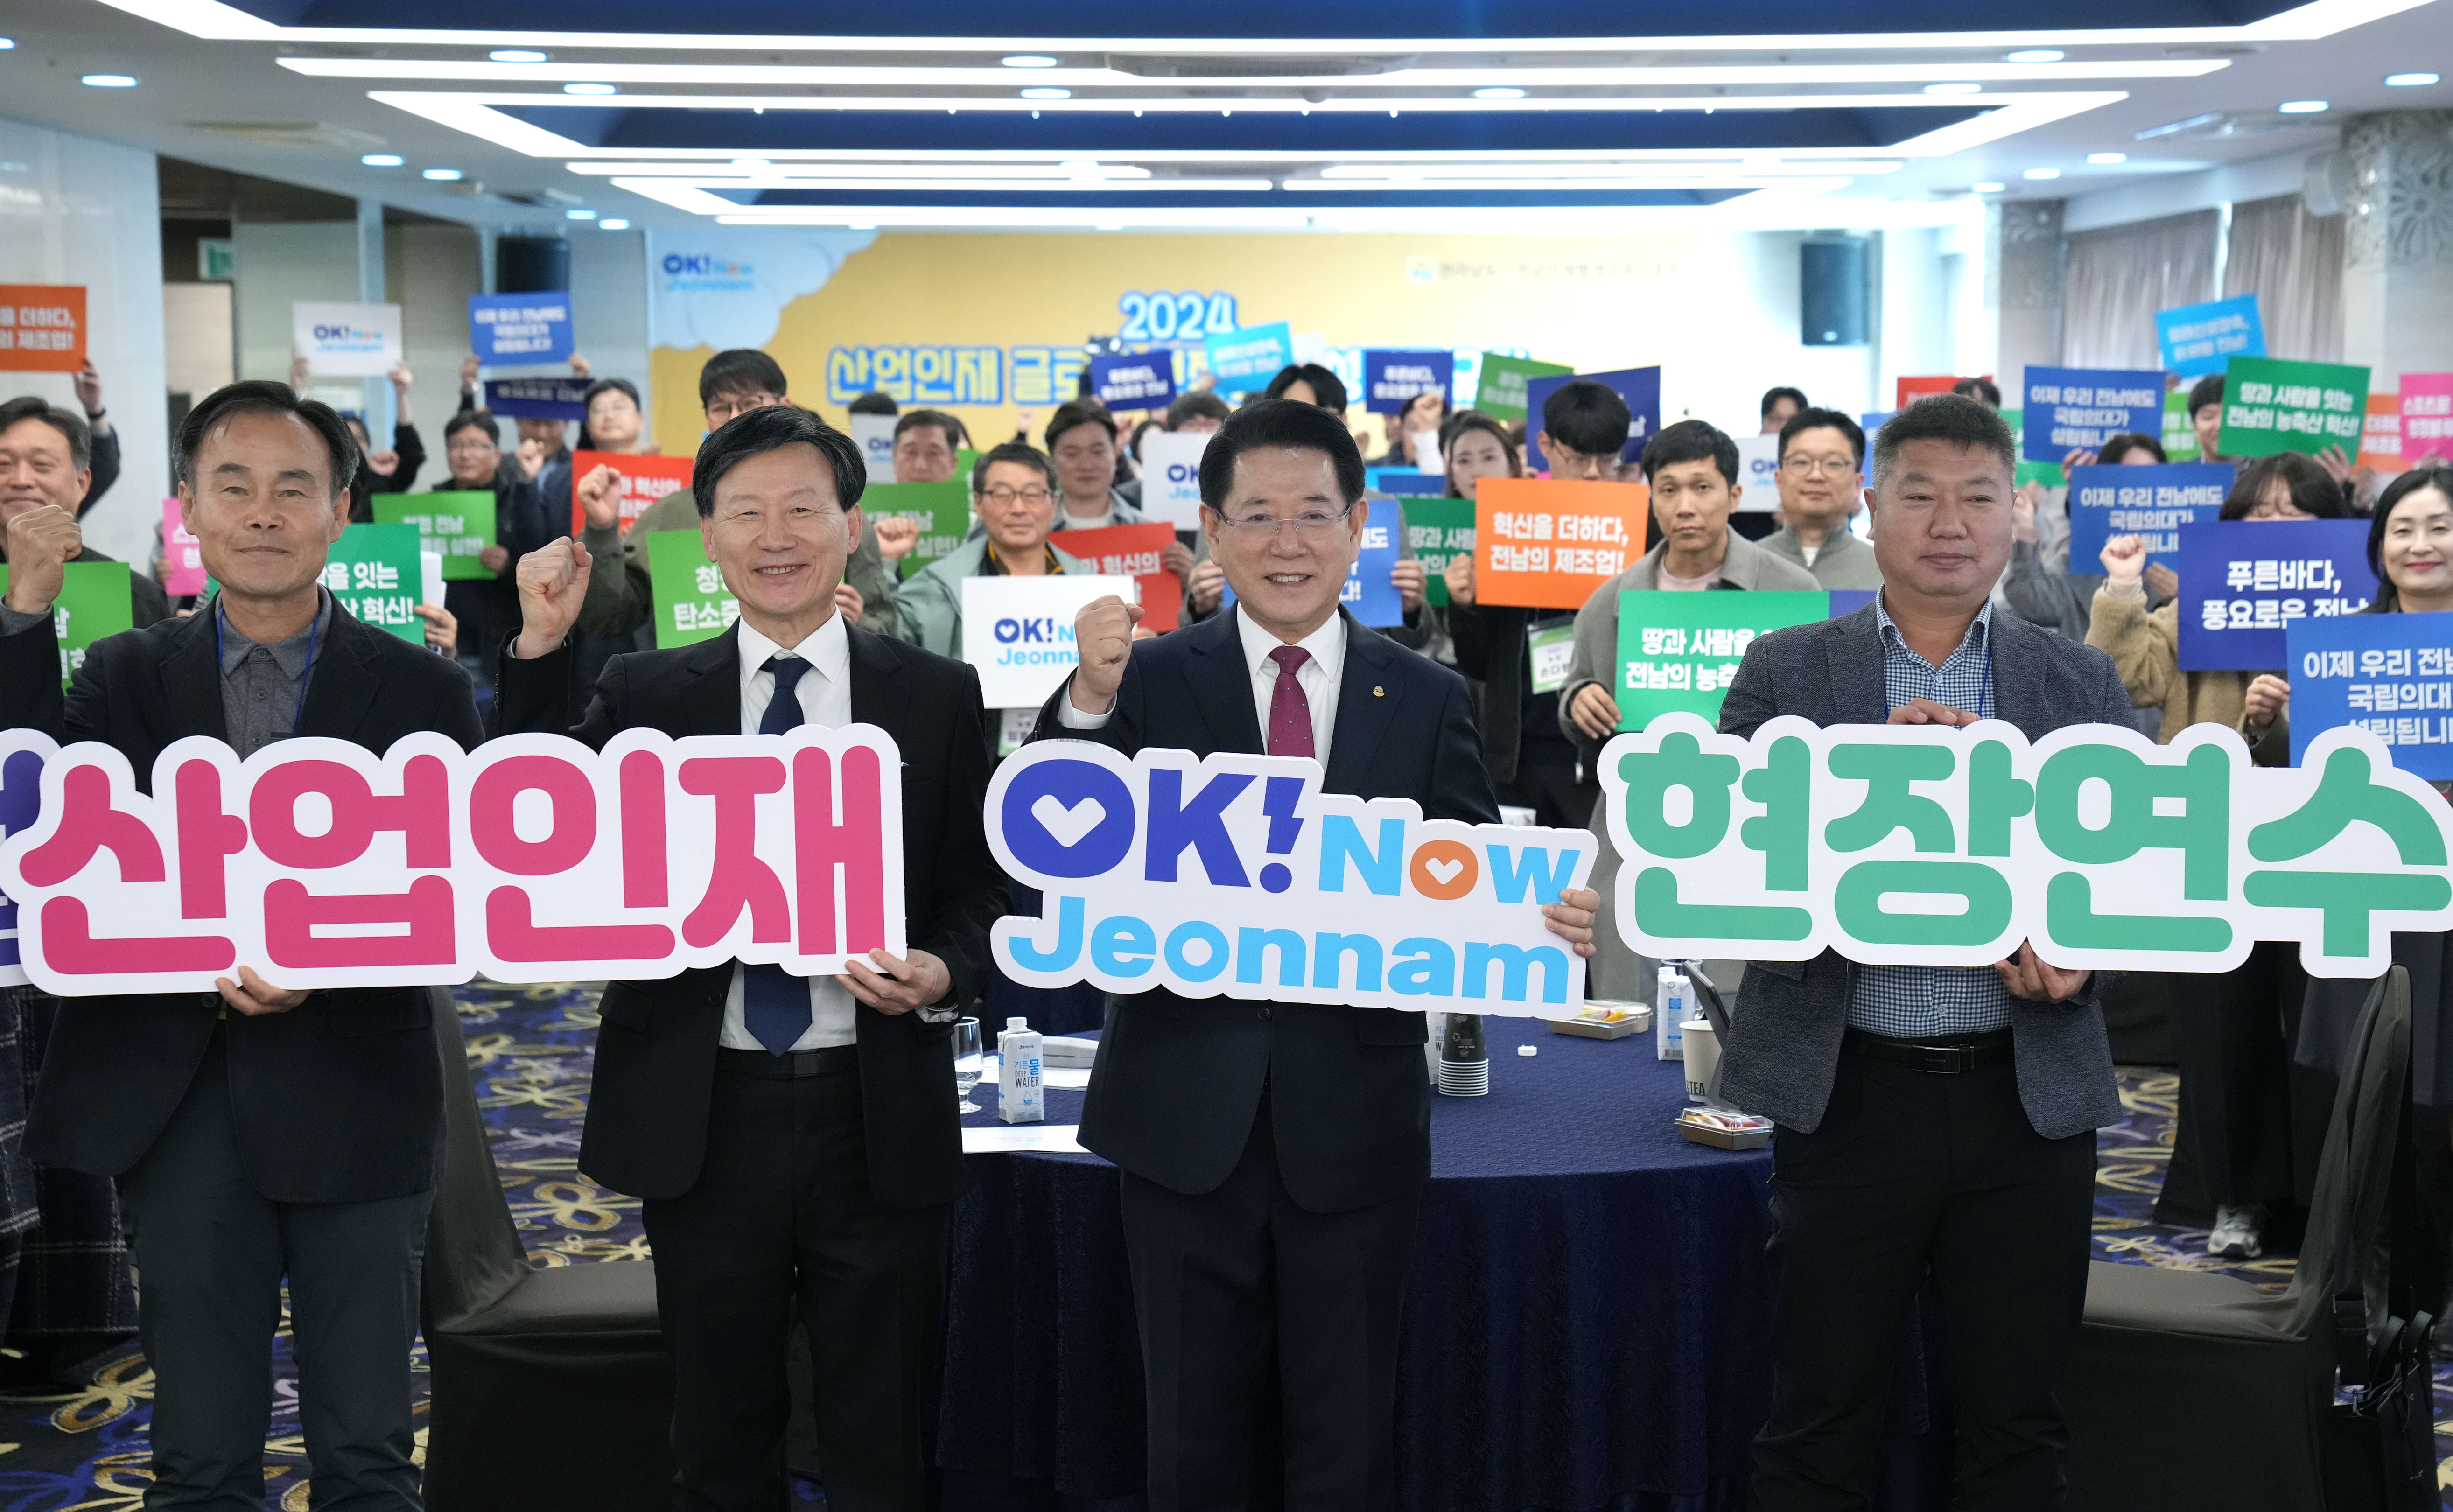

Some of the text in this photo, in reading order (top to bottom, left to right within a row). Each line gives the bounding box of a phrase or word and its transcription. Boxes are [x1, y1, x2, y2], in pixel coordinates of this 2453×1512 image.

[1121, 294, 1237, 340] 2024
[830, 348, 999, 403] 산업인재
[2273, 385, 2322, 410] 사람을
[2227, 405, 2275, 429] 전남의
[2080, 485, 2223, 508] 이제 우리 전남에도
[1493, 511, 1629, 547] 혁신을 더하다,
[353, 561, 399, 590] 잇는
[1103, 551, 1160, 576] 혁신의
[1490, 545, 1625, 576] 전남의 제조업!
[2227, 559, 2342, 595] 푸른바다,
[362, 596, 414, 625] 혁신!
[995, 618, 1053, 644] OK!
[1642, 628, 1755, 656] 땅과 사람을
[1626, 662, 1691, 691] 전남의
[2303, 651, 2354, 679] 이제
[2360, 649, 2411, 678] 우리
[2348, 682, 2453, 712] 국립의대
[2349, 716, 2453, 746] 립됩니
[1001, 758, 1581, 906] OK! Now
[1617, 731, 2453, 958] 현장연수
[19, 745, 885, 975] 산업인재
[1008, 896, 1570, 1004] Jeonnam
[1015, 1076, 1039, 1088] WATER
